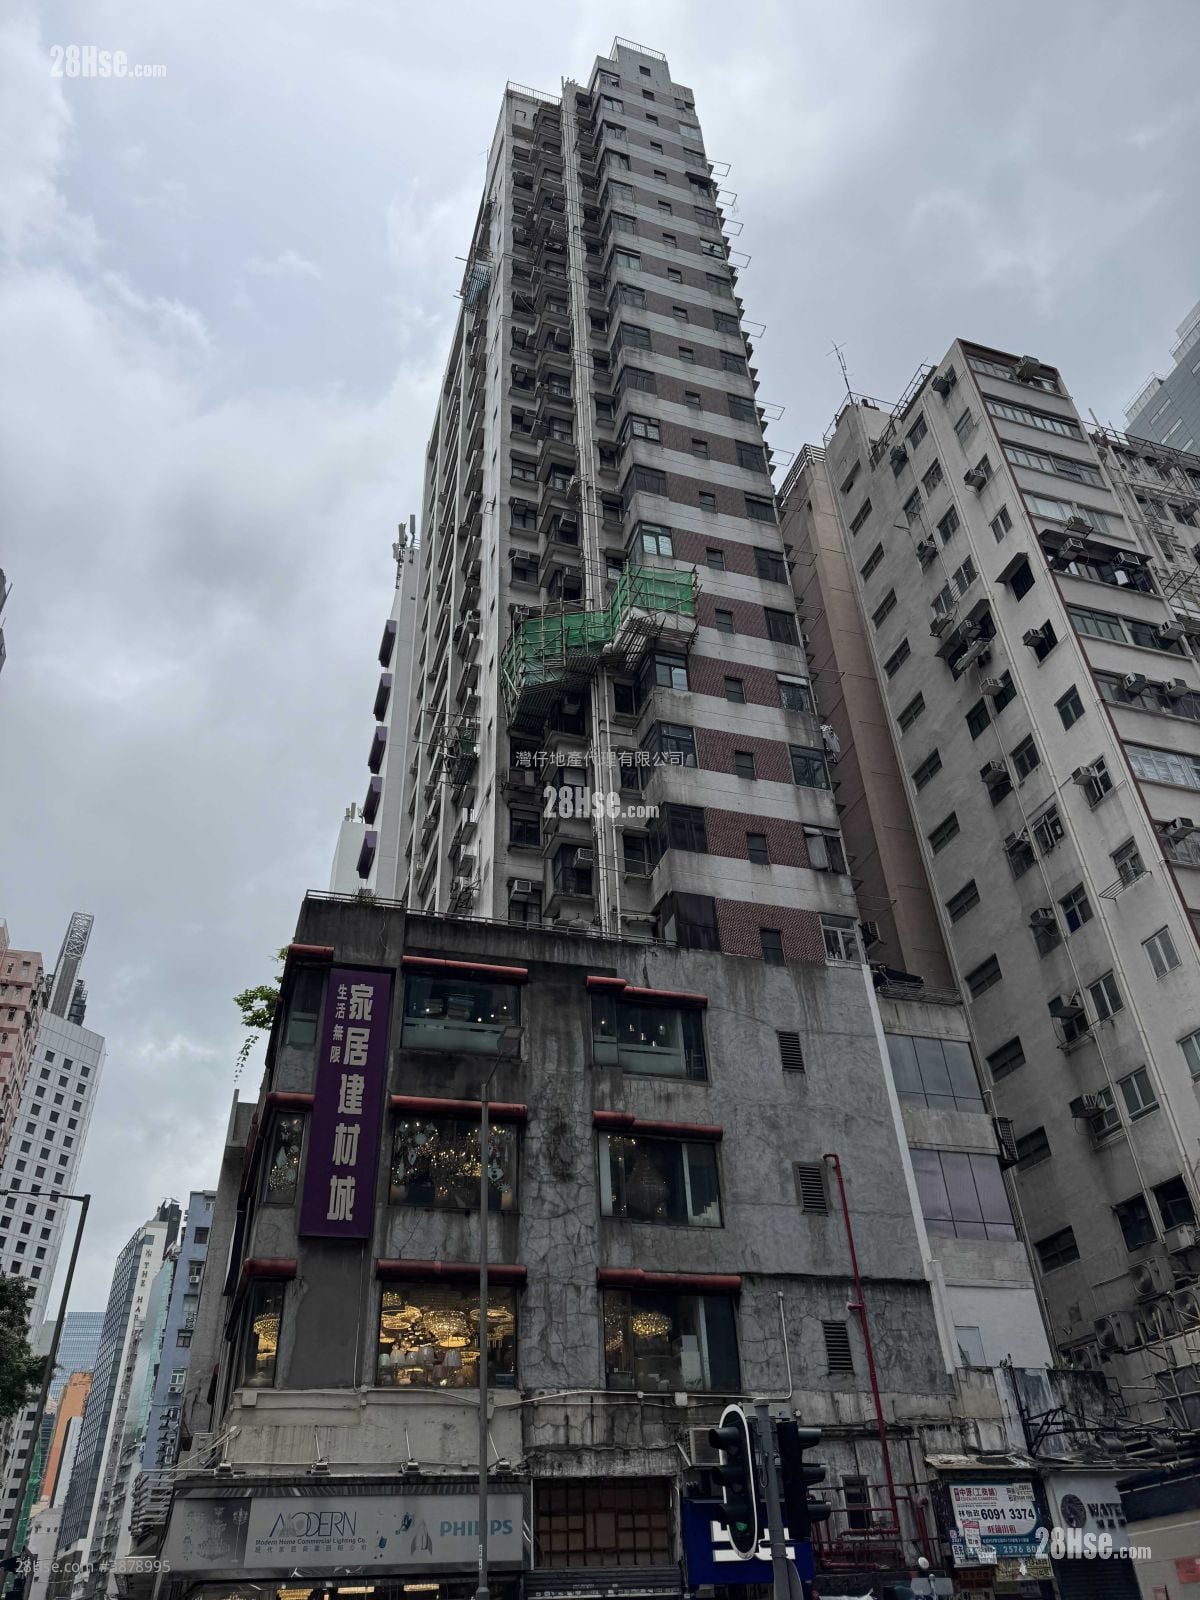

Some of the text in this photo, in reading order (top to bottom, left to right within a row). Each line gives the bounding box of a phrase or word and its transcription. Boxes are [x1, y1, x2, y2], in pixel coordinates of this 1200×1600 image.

[329, 983, 349, 1064] 生活無限
[326, 983, 375, 1222] 家居建材城
[269, 1511, 357, 1537] MODERN
[980, 1508, 1035, 1520] 6091 3374
[440, 1518, 513, 1537] PHILPS
